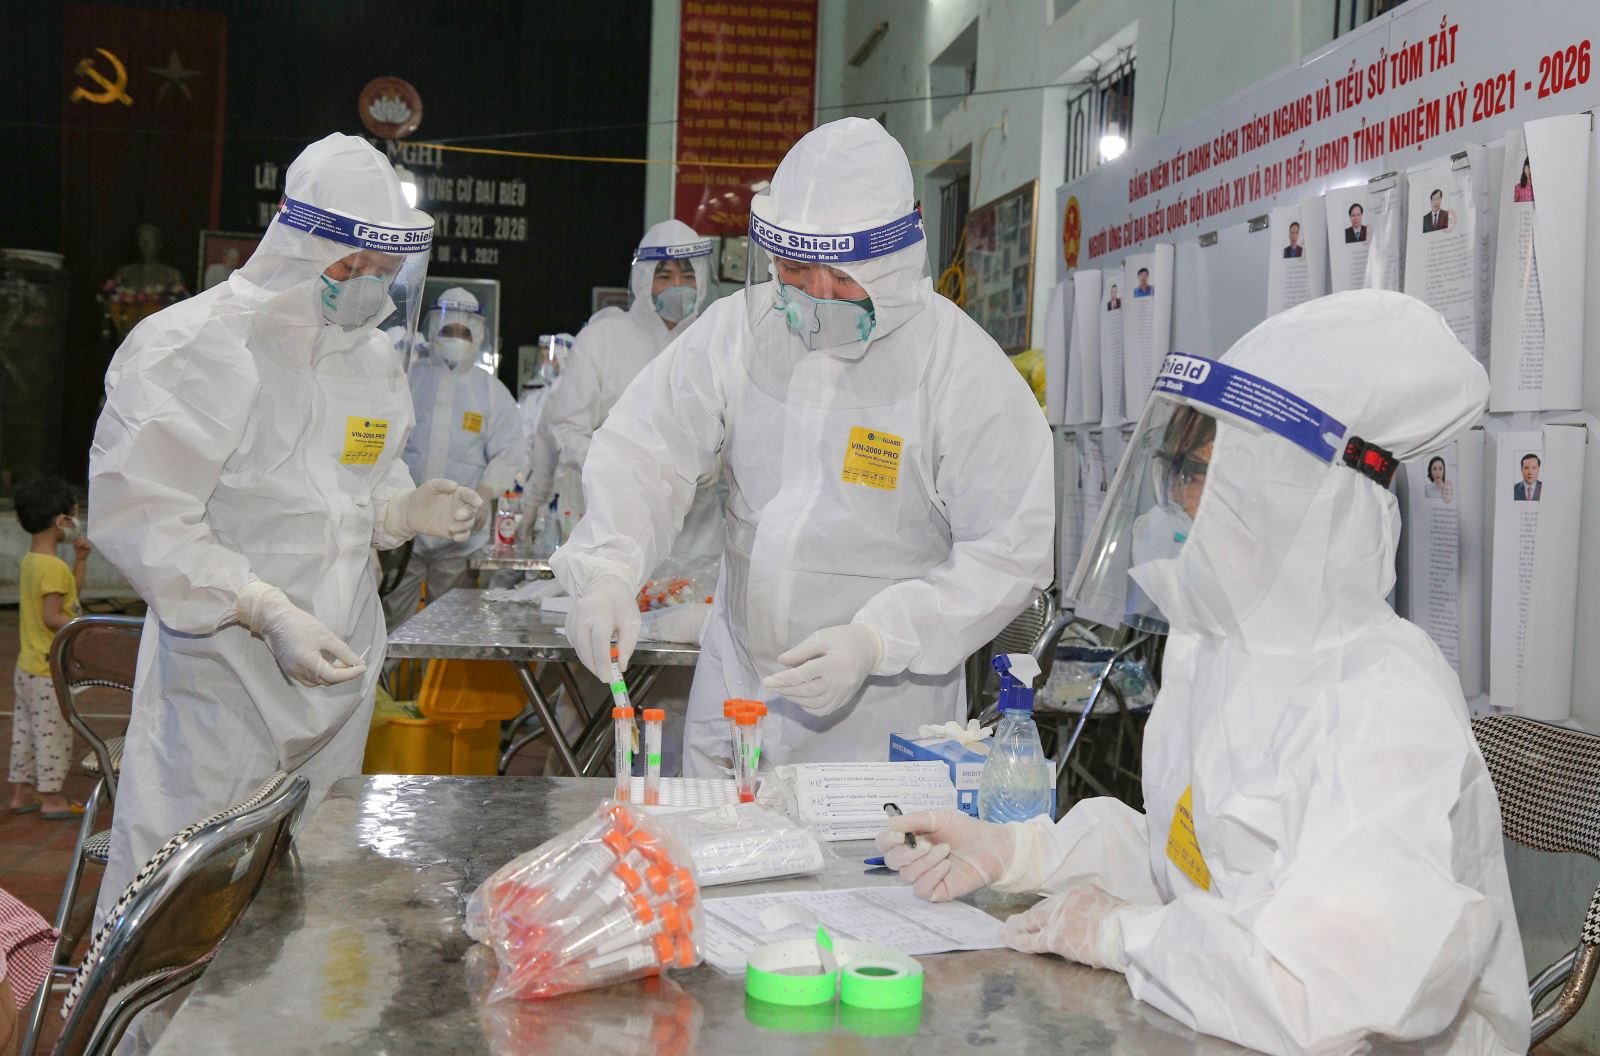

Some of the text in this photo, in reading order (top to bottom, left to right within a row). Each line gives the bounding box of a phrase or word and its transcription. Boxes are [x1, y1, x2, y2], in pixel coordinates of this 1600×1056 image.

[1171, 147, 1185, 184] YẾT
[1188, 142, 1210, 177] DANH
[1213, 129, 1238, 166] SÁCH
[1241, 113, 1270, 154] TRÍCH
[1273, 94, 1312, 140] NGANG
[1316, 79, 1331, 122] VÀ
[1335, 58, 1363, 113] TIỂU
[1367, 47, 1387, 99] SỬ
[1390, 40, 1423, 89] TÓM
[1428, 14, 1458, 72] TẮT
[1167, 191, 1187, 234] QUỐC
[1190, 189, 1204, 227] HỘI
[1206, 179, 1231, 217] KHÓA
[1233, 176, 1246, 209] XV
[1249, 164, 1261, 202] VÀ
[1264, 162, 1282, 201] ĐẠI
[1285, 139, 1312, 189] BIỂU
[1315, 136, 1349, 179] HĐND
[1353, 117, 1385, 164] TỈNH
[1389, 98, 1440, 150] NHIỆM
[1446, 81, 1468, 132] KỲ
[1472, 69, 1516, 123] 2021
[1538, 39, 1591, 100] 2026
[358, 226, 399, 242] Face
[455, 214, 483, 239] 2021
[495, 216, 527, 241] 2026
[753, 218, 782, 243] Face
[789, 235, 850, 251] Shield
[366, 242, 399, 251] Protective
[759, 237, 784, 254] Protective
[786, 250, 816, 260] Isolation
[852, 442, 899, 460] VIN-2000 PRO
